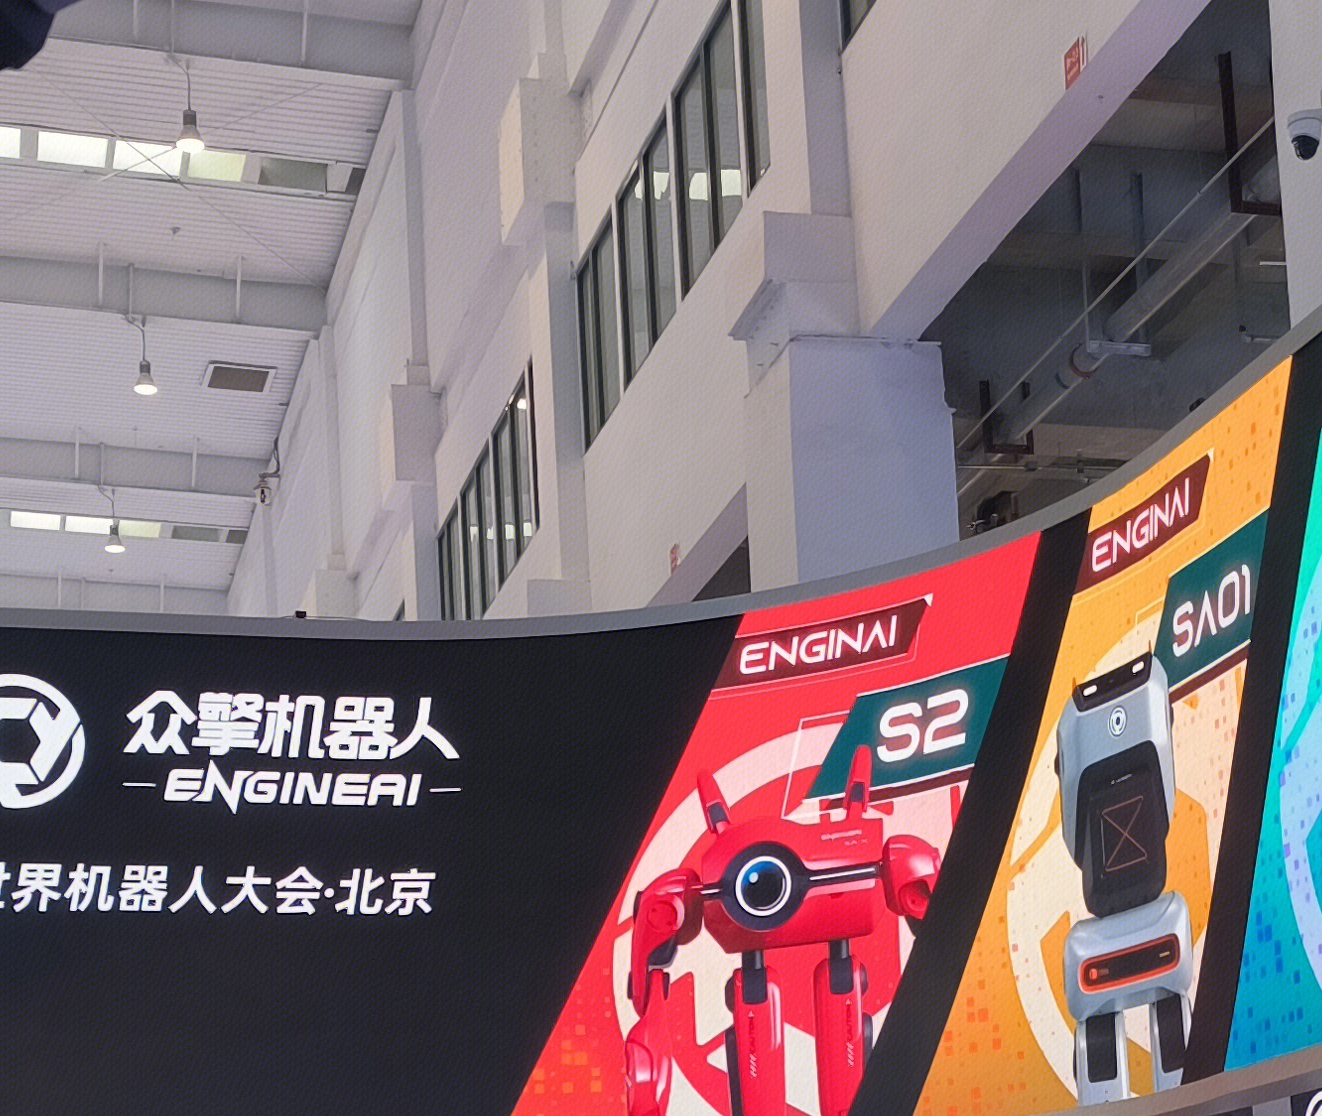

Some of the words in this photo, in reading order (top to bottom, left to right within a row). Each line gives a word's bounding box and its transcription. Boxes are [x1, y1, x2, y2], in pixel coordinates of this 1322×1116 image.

[1092, 479, 1190, 571] ENGINAI
[738, 616, 898, 675] ENGINAI
[1172, 564, 1251, 658] SA01
[122, 690, 461, 761] 众擎机器人
[877, 689, 970, 763] S2
[164, 761, 423, 813] ENGINEAI
